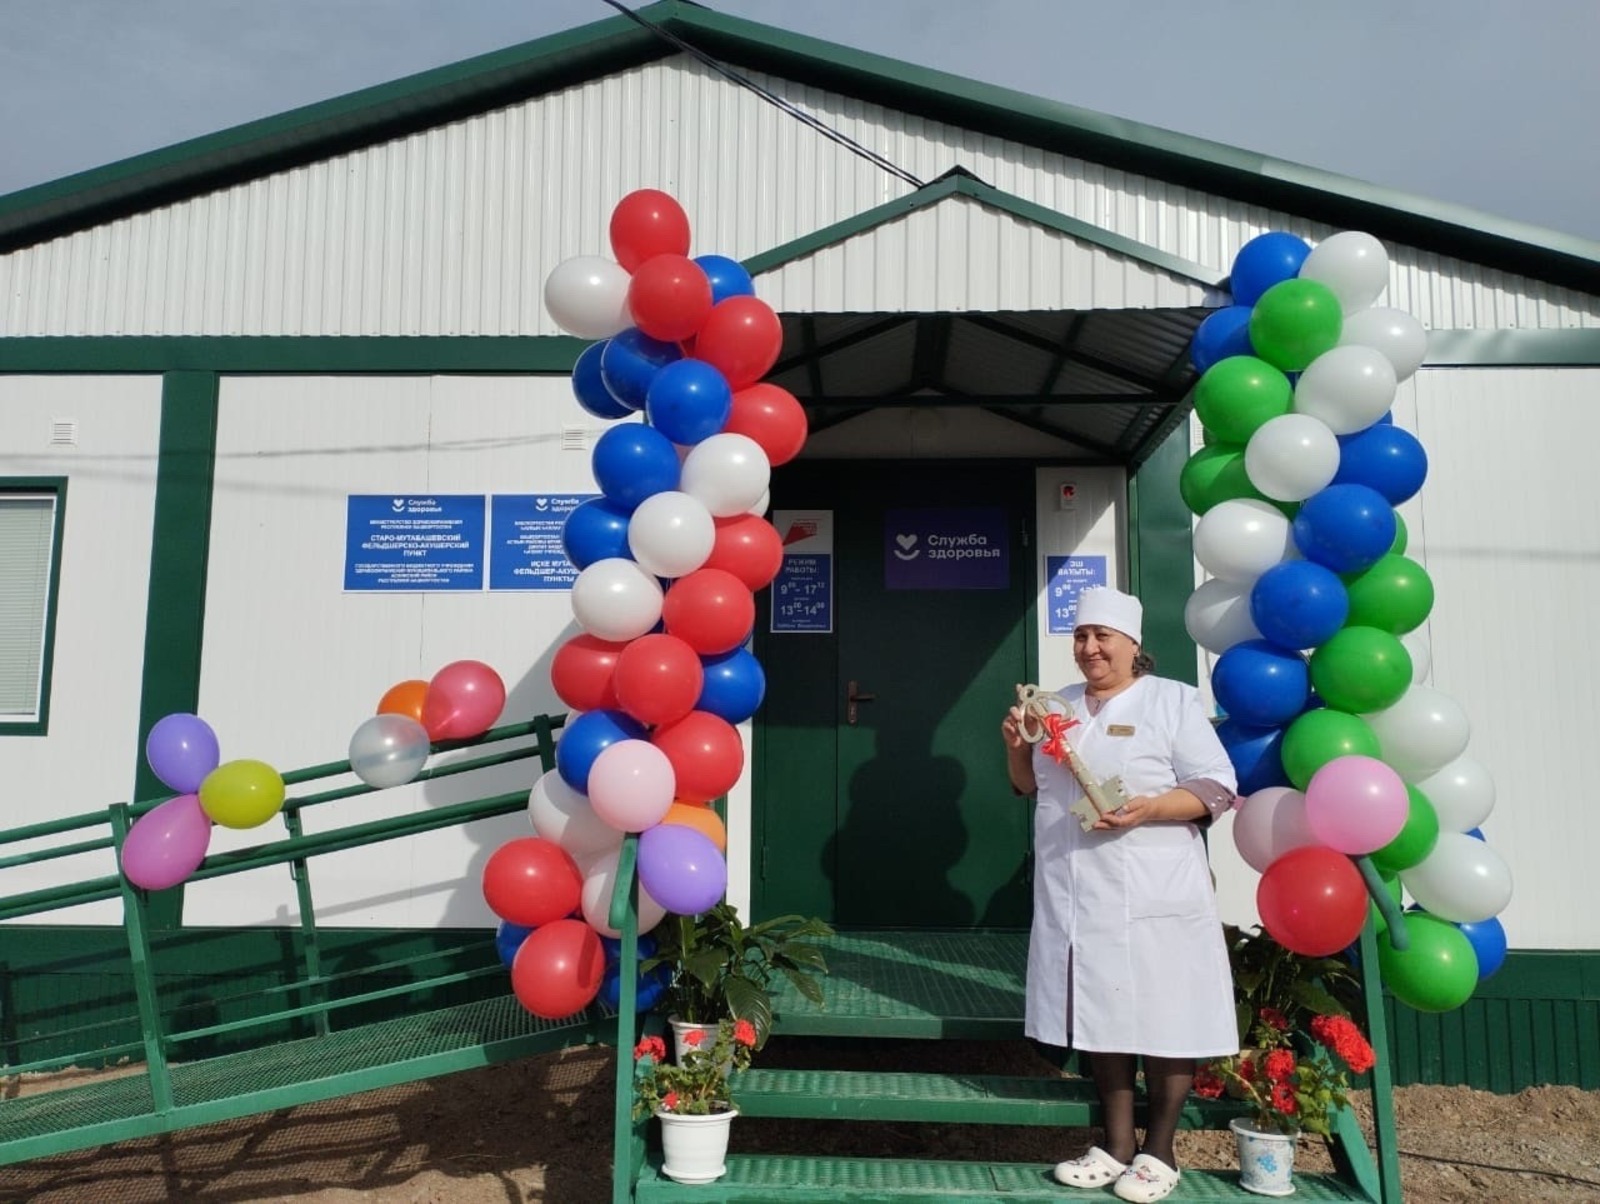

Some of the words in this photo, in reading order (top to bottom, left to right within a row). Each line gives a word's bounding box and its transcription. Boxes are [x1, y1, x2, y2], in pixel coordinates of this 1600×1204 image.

[928, 533, 987, 549] Служба
[403, 549, 427, 557] ПУНКТ
[928, 549, 1001, 561] здоровья
